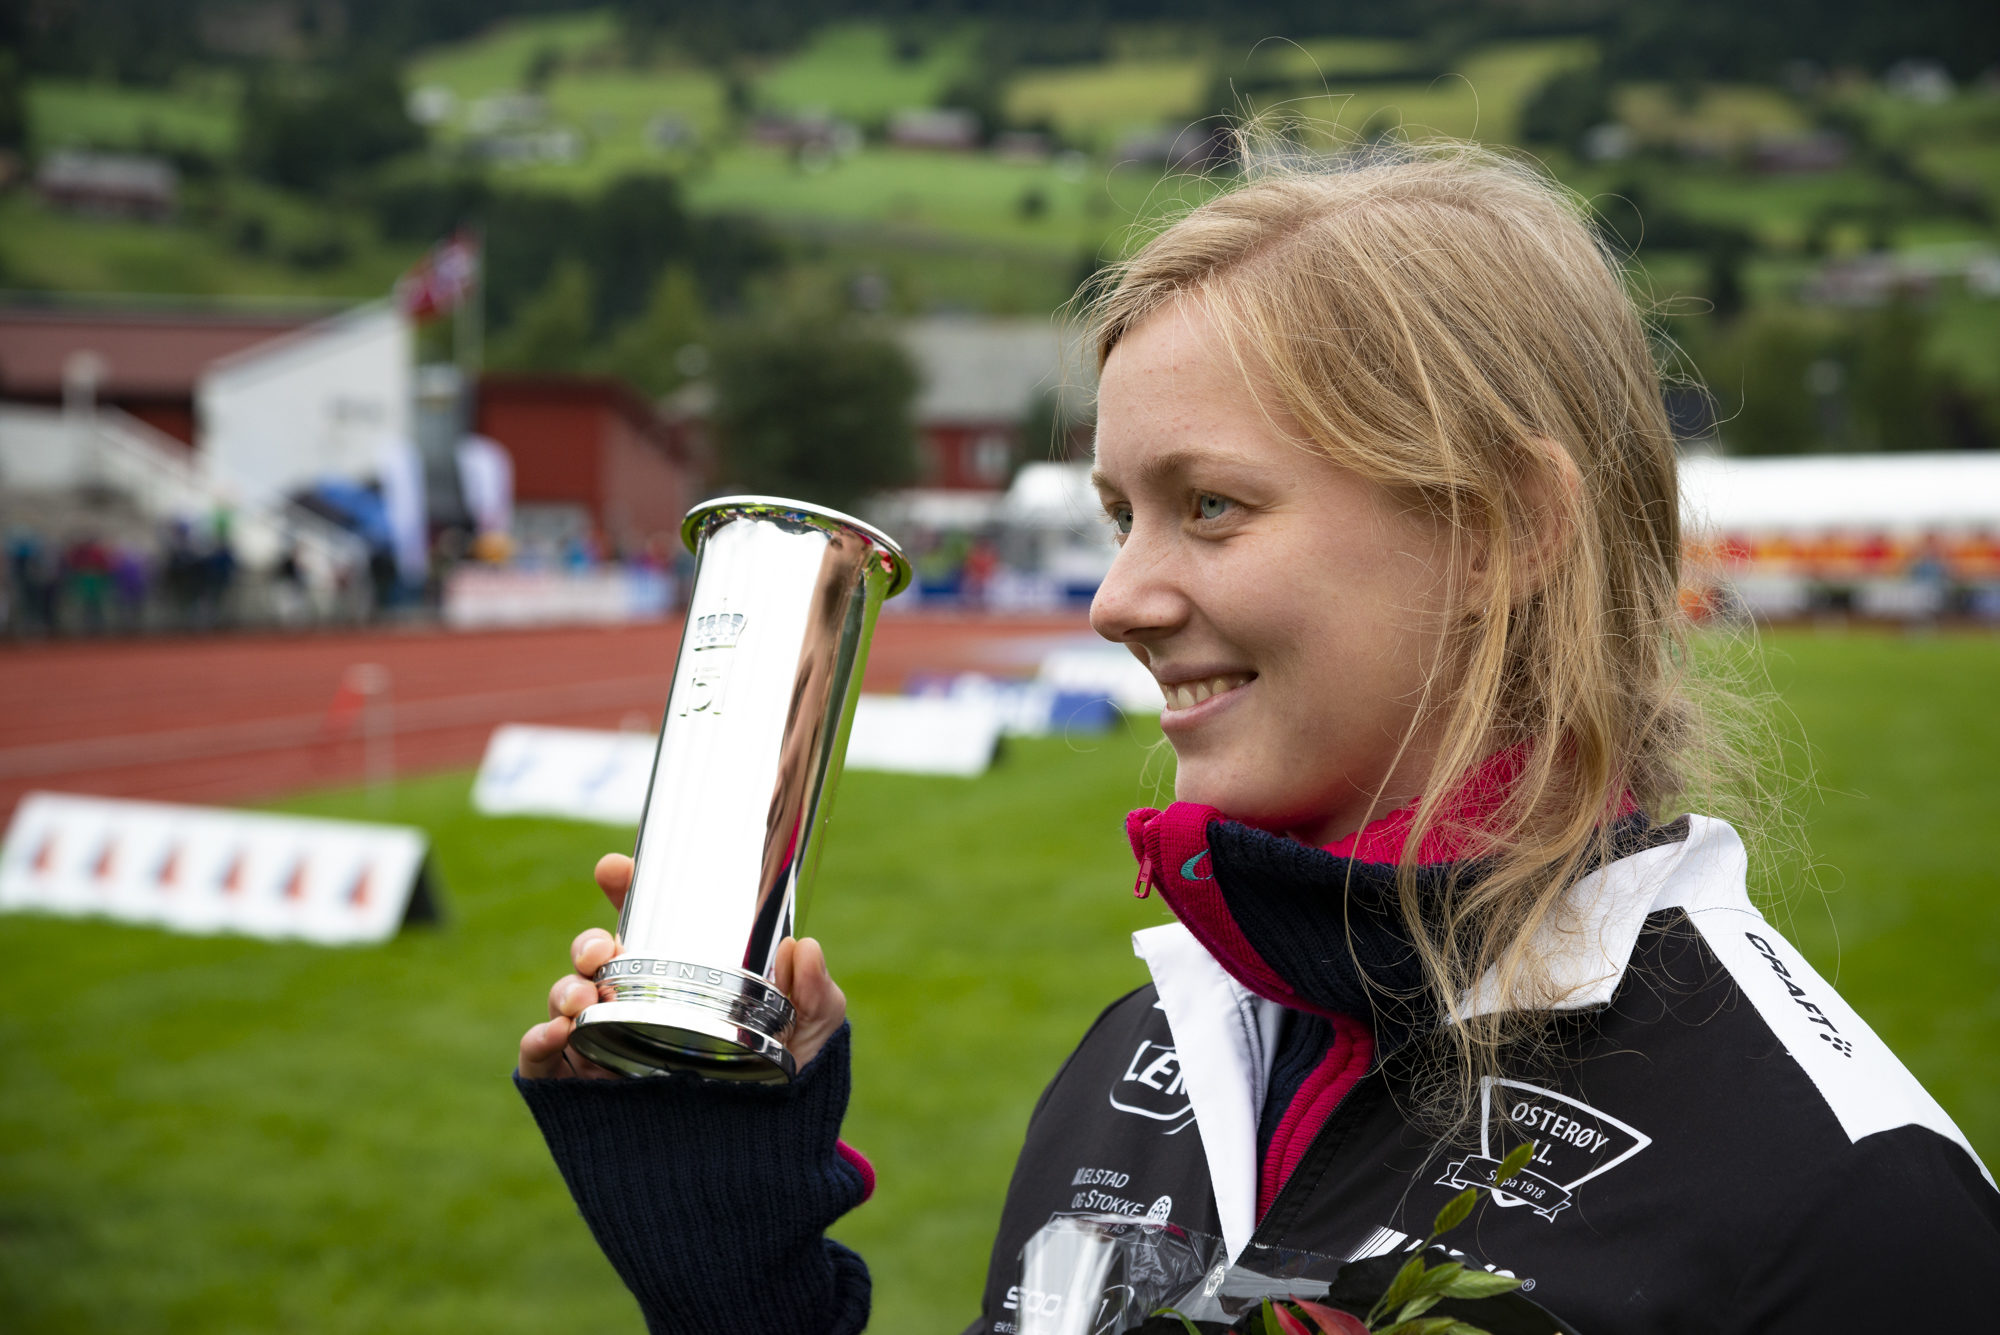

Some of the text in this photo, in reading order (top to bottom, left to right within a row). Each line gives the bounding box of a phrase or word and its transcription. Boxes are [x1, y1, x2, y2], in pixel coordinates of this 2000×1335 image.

[1745, 932, 1839, 1034] CRAFT
[1511, 1102, 1610, 1154] OSTERØY
[1084, 1189, 1145, 1217] STOKKE
[1519, 1180, 1545, 1200] 1918
